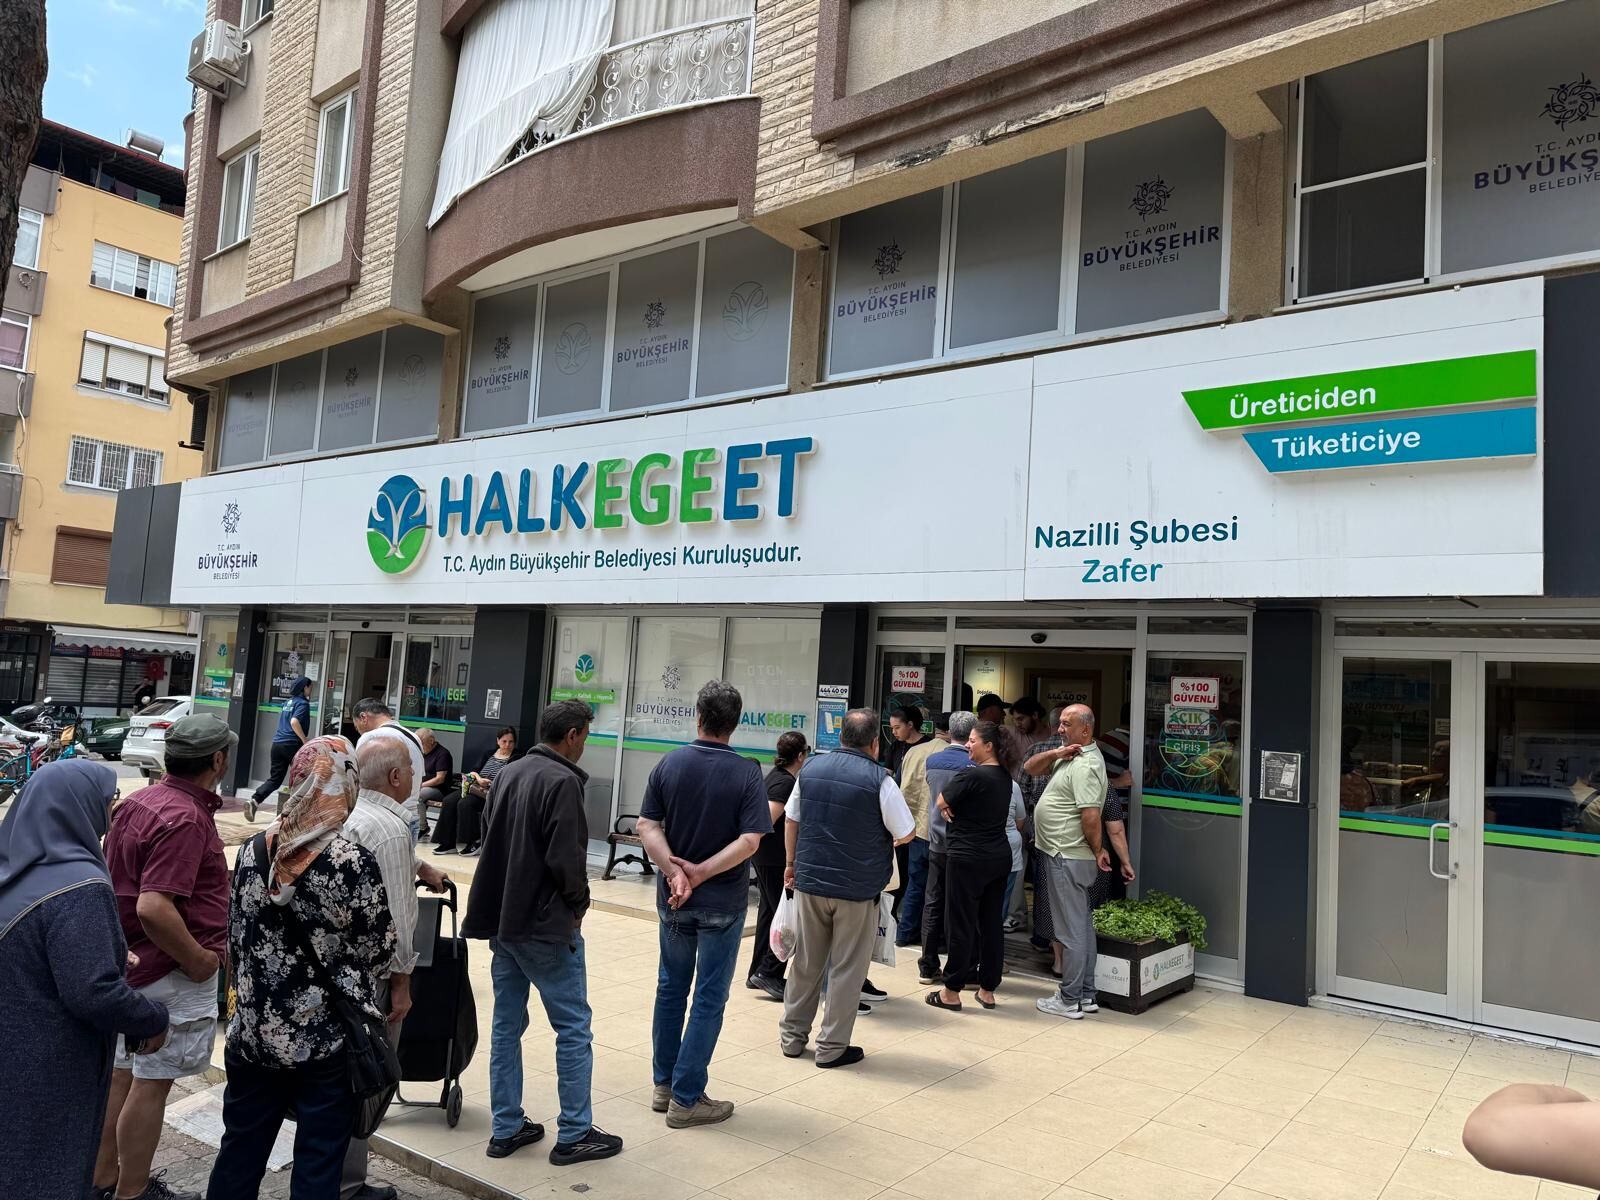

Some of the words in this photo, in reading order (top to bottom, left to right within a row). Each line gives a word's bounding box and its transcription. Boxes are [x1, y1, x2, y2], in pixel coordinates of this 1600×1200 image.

[1535, 142, 1561, 153] T.C.
[1474, 149, 1599, 189] BÜYÜKŞ
[1125, 229, 1142, 240] T.C.
[1146, 221, 1177, 235] AYDIN
[1083, 225, 1220, 268] BÜYÜKŞEHİR
[1119, 253, 1180, 272] BELEDİYESİ
[883, 281, 906, 292] AYDIN
[837, 285, 938, 318] BÜYÜKŞEHİR
[863, 308, 908, 324] BELEDİYESİ
[617, 339, 689, 364] BÜYÜKŞEHİR
[471, 369, 530, 389] BÜYÜKŞEHİR
[1229, 385, 1377, 420] Üreticiden
[1271, 429, 1422, 460] Tüketiciye
[438, 436, 814, 538] HALKEGEET
[1034, 521, 1120, 548] Nazilli
[1129, 515, 1240, 551] Şubesi
[197, 551, 258, 572] BÜYÜKŞEHİR
[443, 555, 466, 573] T.C.
[469, 554, 506, 576] Aydın
[509, 551, 591, 575] Büyükşehir
[594, 546, 678, 572] Belediyesi
[683, 542, 802, 567] Kuruluşudur.
[1082, 558, 1163, 583] Zafer
[893, 679, 923, 690] GÜVENLİ
[898, 670, 919, 679] %100
[1180, 682, 1210, 692] %100
[1173, 692, 1217, 704] GÜVENLİ
[636, 702, 697, 718] BÜYÜKŞEHİ
[737, 711, 807, 730] ALKEGEET
